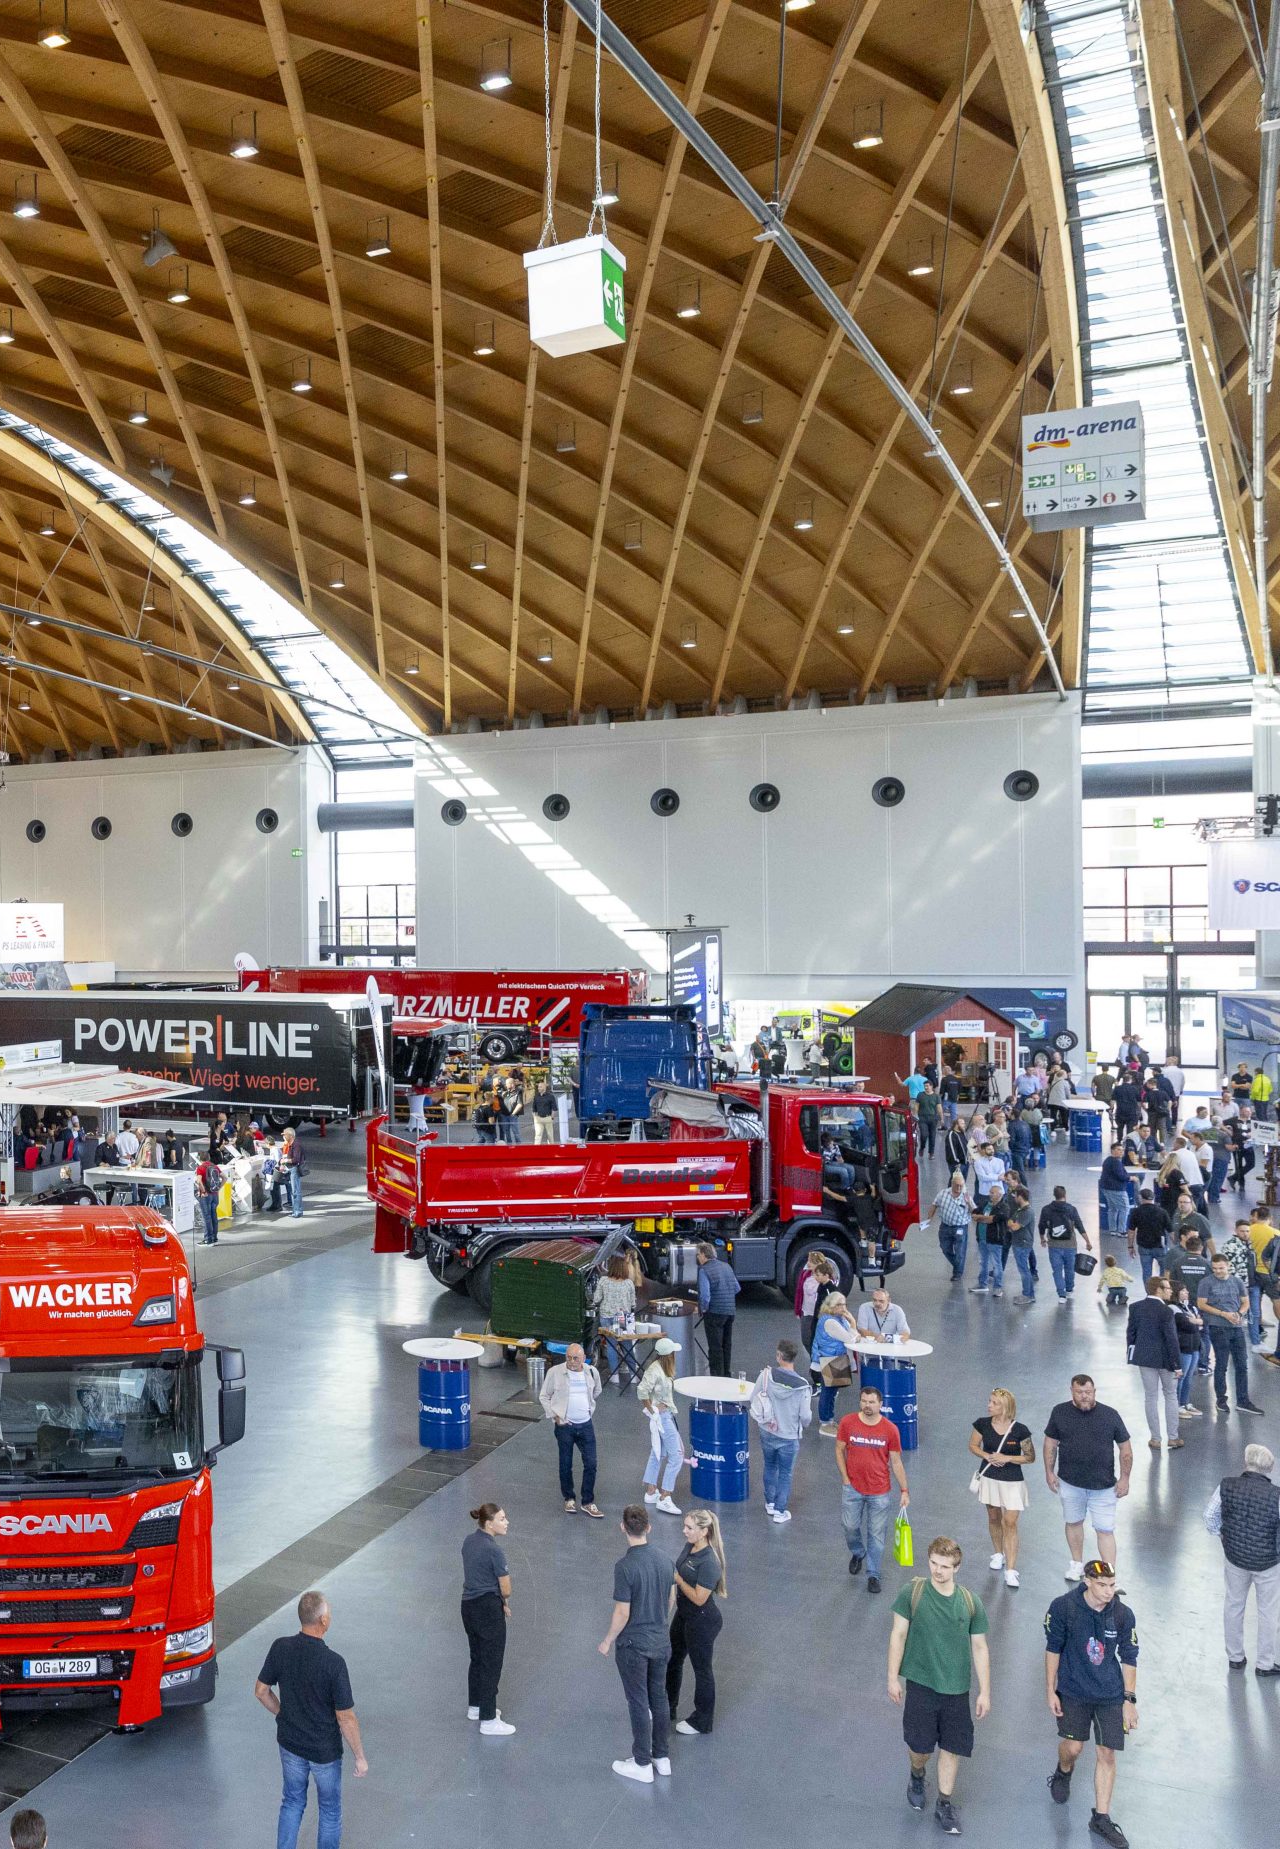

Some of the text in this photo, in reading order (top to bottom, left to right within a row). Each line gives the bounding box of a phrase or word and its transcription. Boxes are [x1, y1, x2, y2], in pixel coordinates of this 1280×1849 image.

[1033, 416, 1137, 443] dm-arena
[508, 982, 546, 990] elektrischem
[548, 983, 579, 991] QuickTOP
[392, 995, 531, 1018] ARZMÜLLER
[74, 1017, 215, 1055] POWER
[189, 1066, 241, 1092] Wiegt
[245, 1074, 321, 1096] weniger.
[622, 1167, 718, 1185] Baader
[8, 1282, 133, 1308] WACKER
[48, 1308, 134, 1319] Wir machen glücklich.
[423, 1405, 453, 1415] SCANIA
[694, 1450, 726, 1462] SCANIA
[16, 1572, 98, 1585] SUPER
[34, 1660, 51, 1674] OG
[68, 1660, 91, 1674] 289
